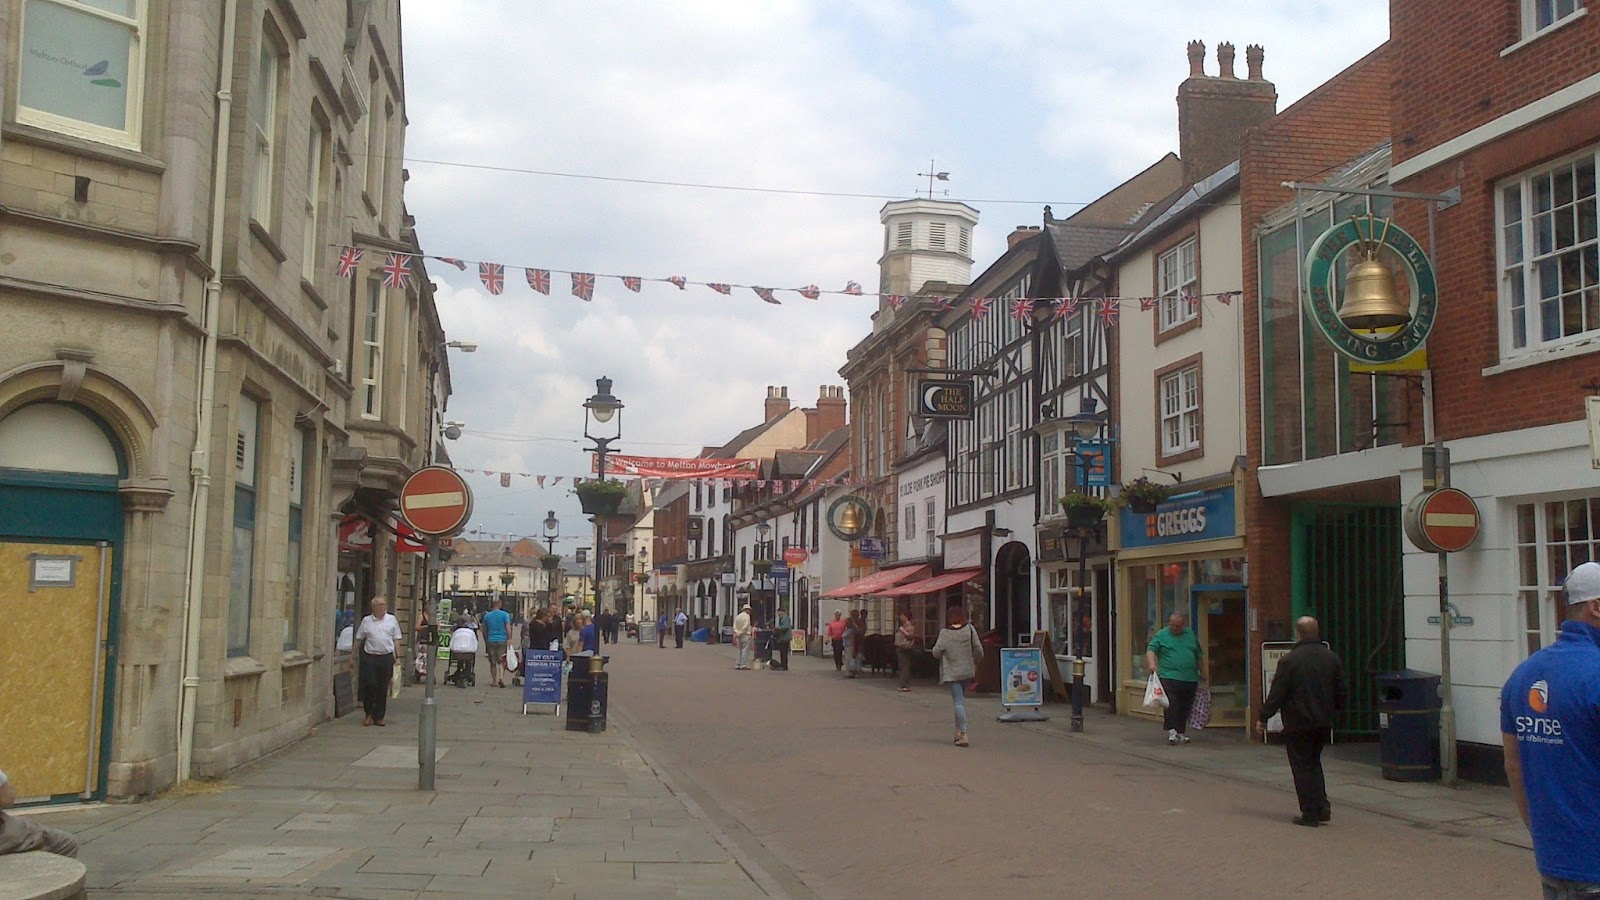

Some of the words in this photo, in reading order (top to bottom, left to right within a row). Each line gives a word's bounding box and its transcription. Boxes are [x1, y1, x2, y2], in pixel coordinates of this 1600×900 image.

[943, 388, 962, 396] THE
[940, 396, 964, 404] HALF
[938, 404, 967, 412] MOON
[616, 457, 655, 467] Welcome
[668, 460, 696, 470] Melton
[698, 461, 736, 471] Mowbray
[1157, 506, 1206, 536] GREGGS
[1516, 716, 1561, 735] sense
